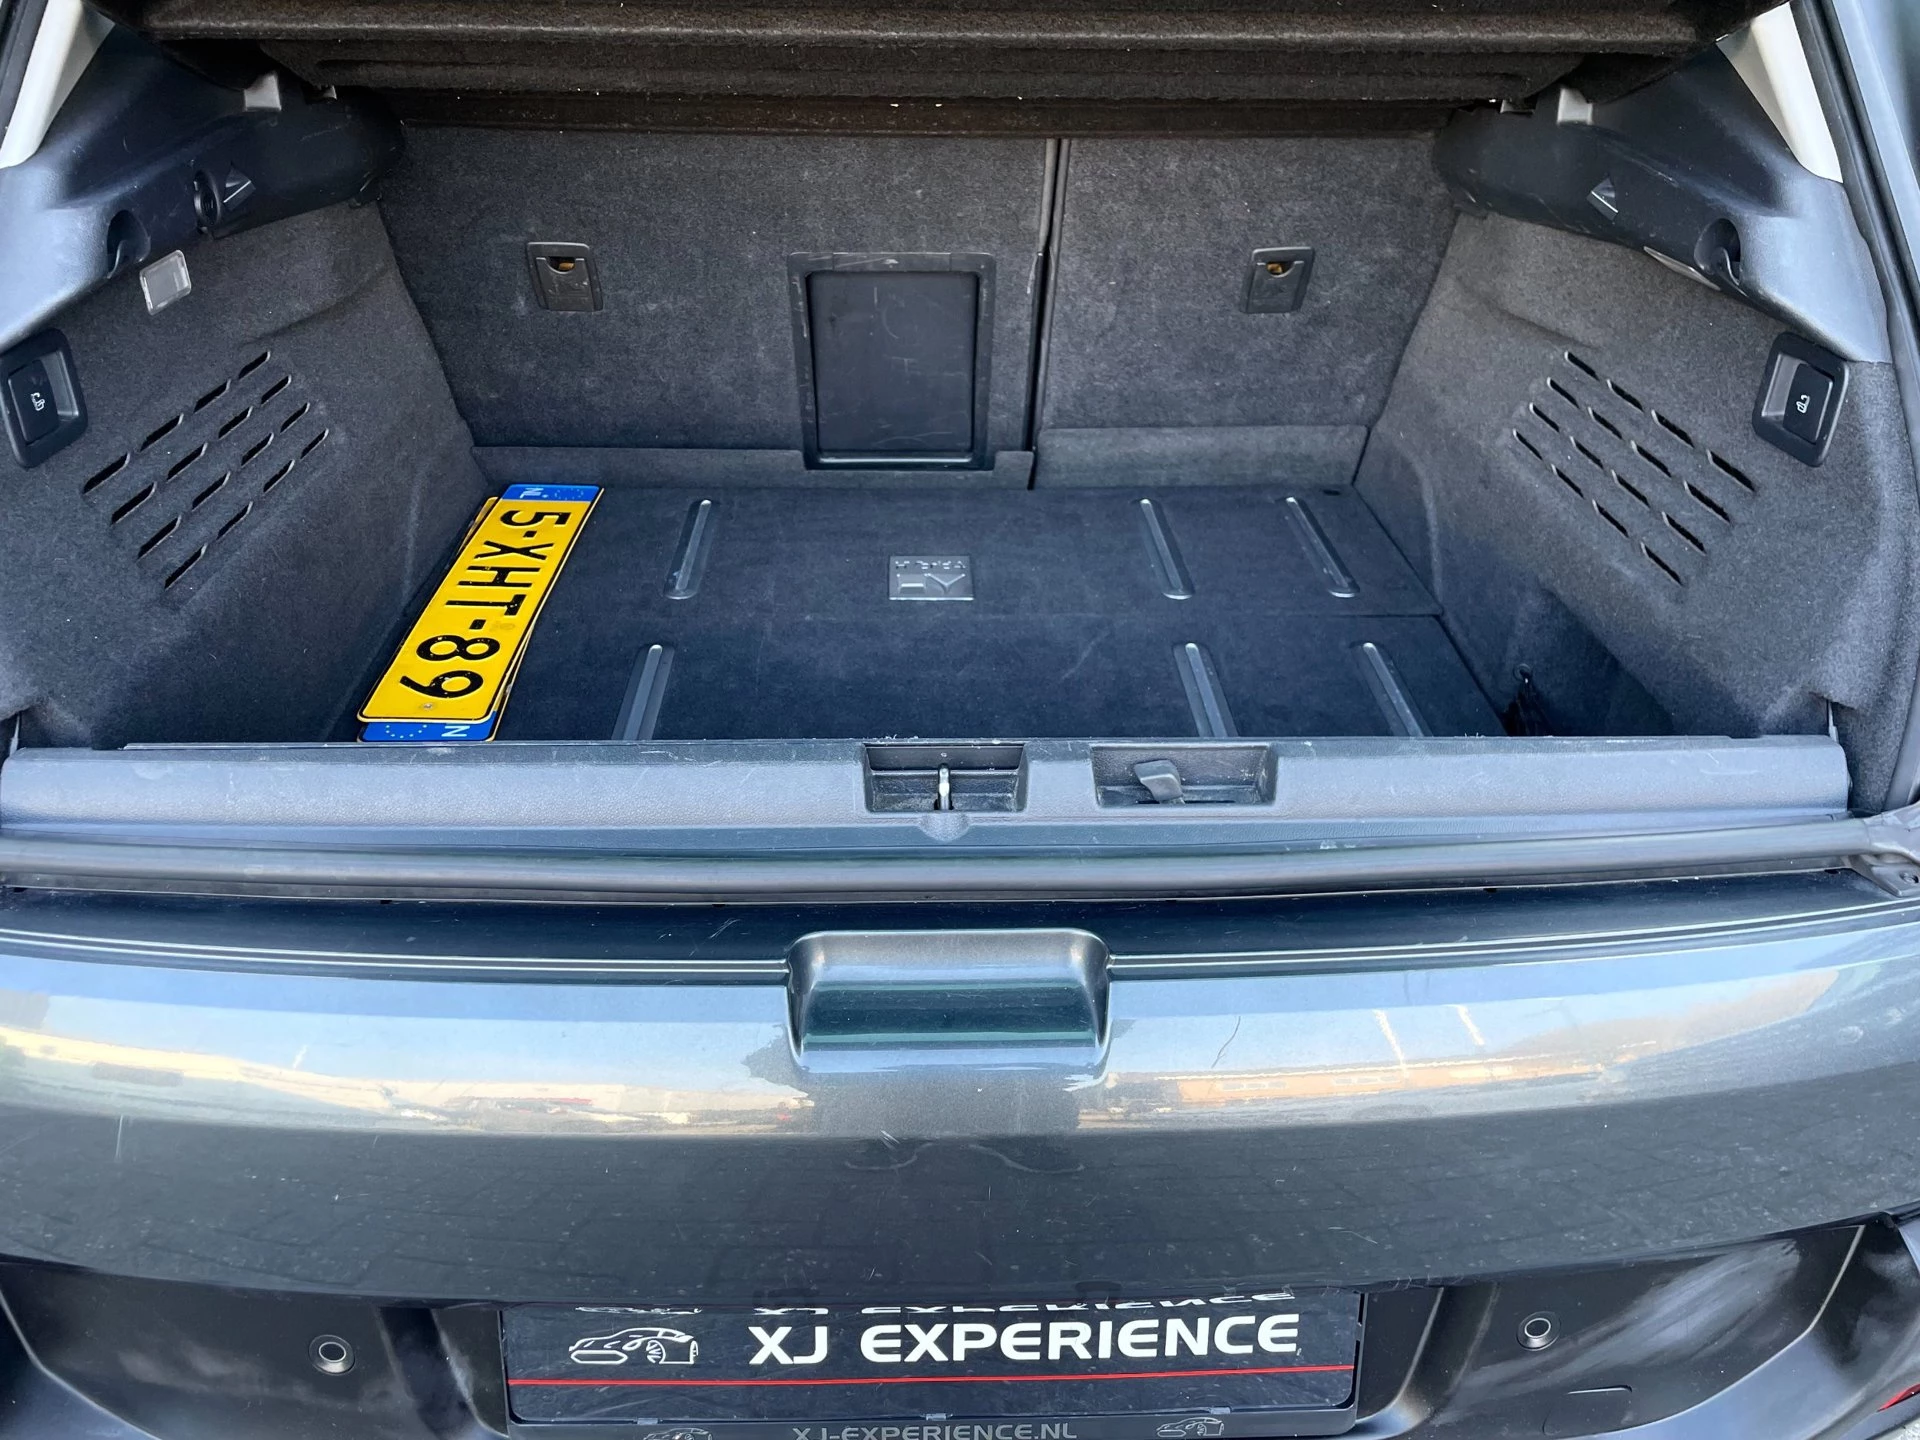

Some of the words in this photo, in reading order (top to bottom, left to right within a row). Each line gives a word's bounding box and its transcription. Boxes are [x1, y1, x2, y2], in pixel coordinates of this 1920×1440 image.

[399, 509, 572, 699] 5-XHT-89
[440, 725, 471, 737] N
[748, 1325, 829, 1365] XJ
[860, 1313, 1300, 1364] EXPERIENCE
